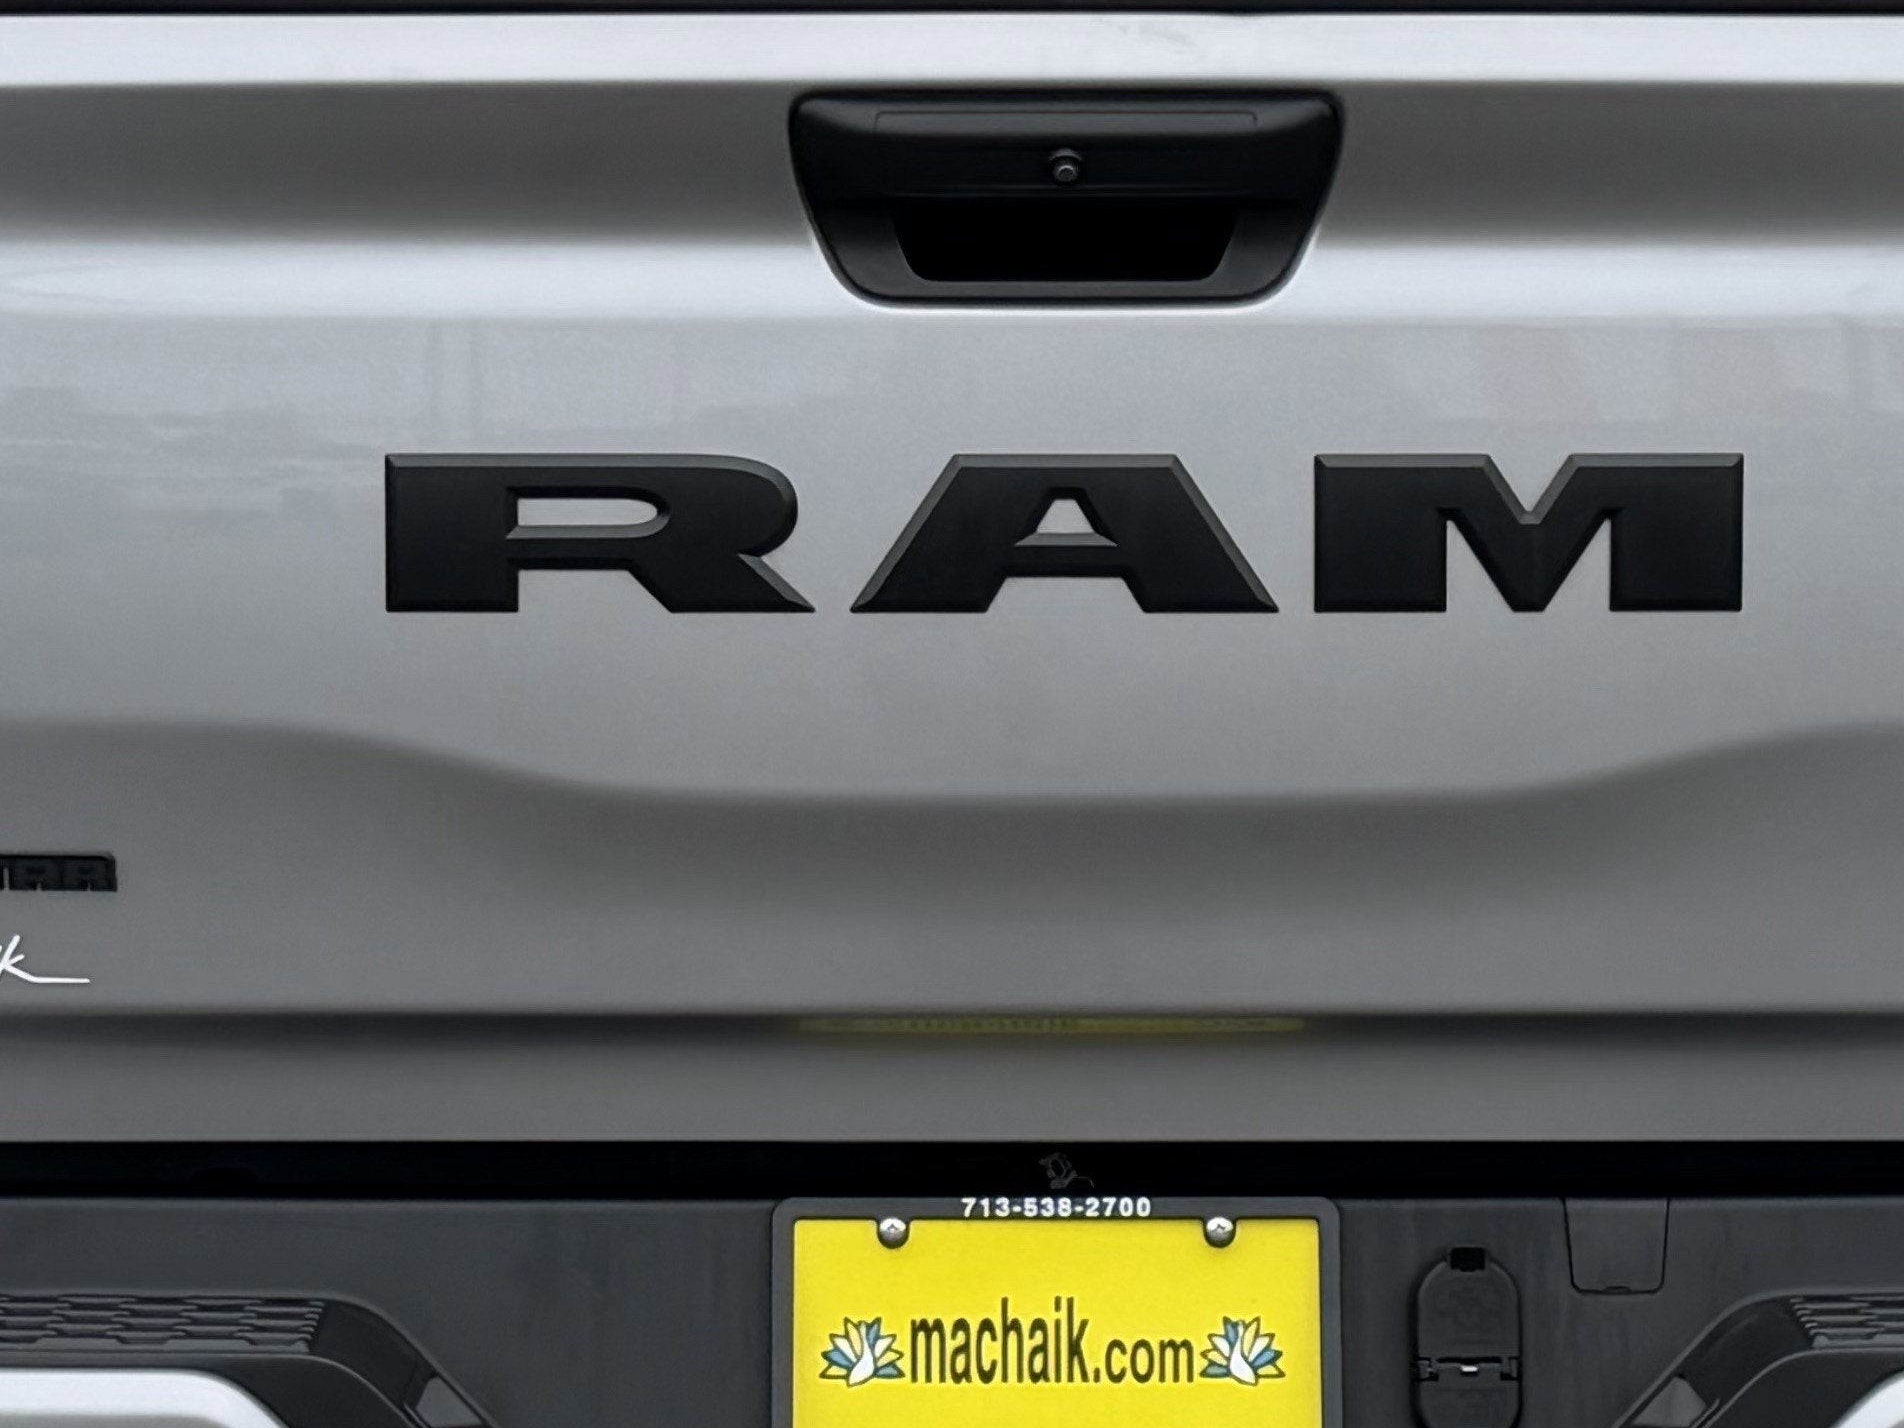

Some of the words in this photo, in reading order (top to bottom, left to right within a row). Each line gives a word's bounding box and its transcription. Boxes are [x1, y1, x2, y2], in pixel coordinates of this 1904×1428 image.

[385, 452, 1744, 613] RAM
[960, 1196, 1152, 1218] 713-538-2700
[909, 1296, 1196, 1385] machaik.com
